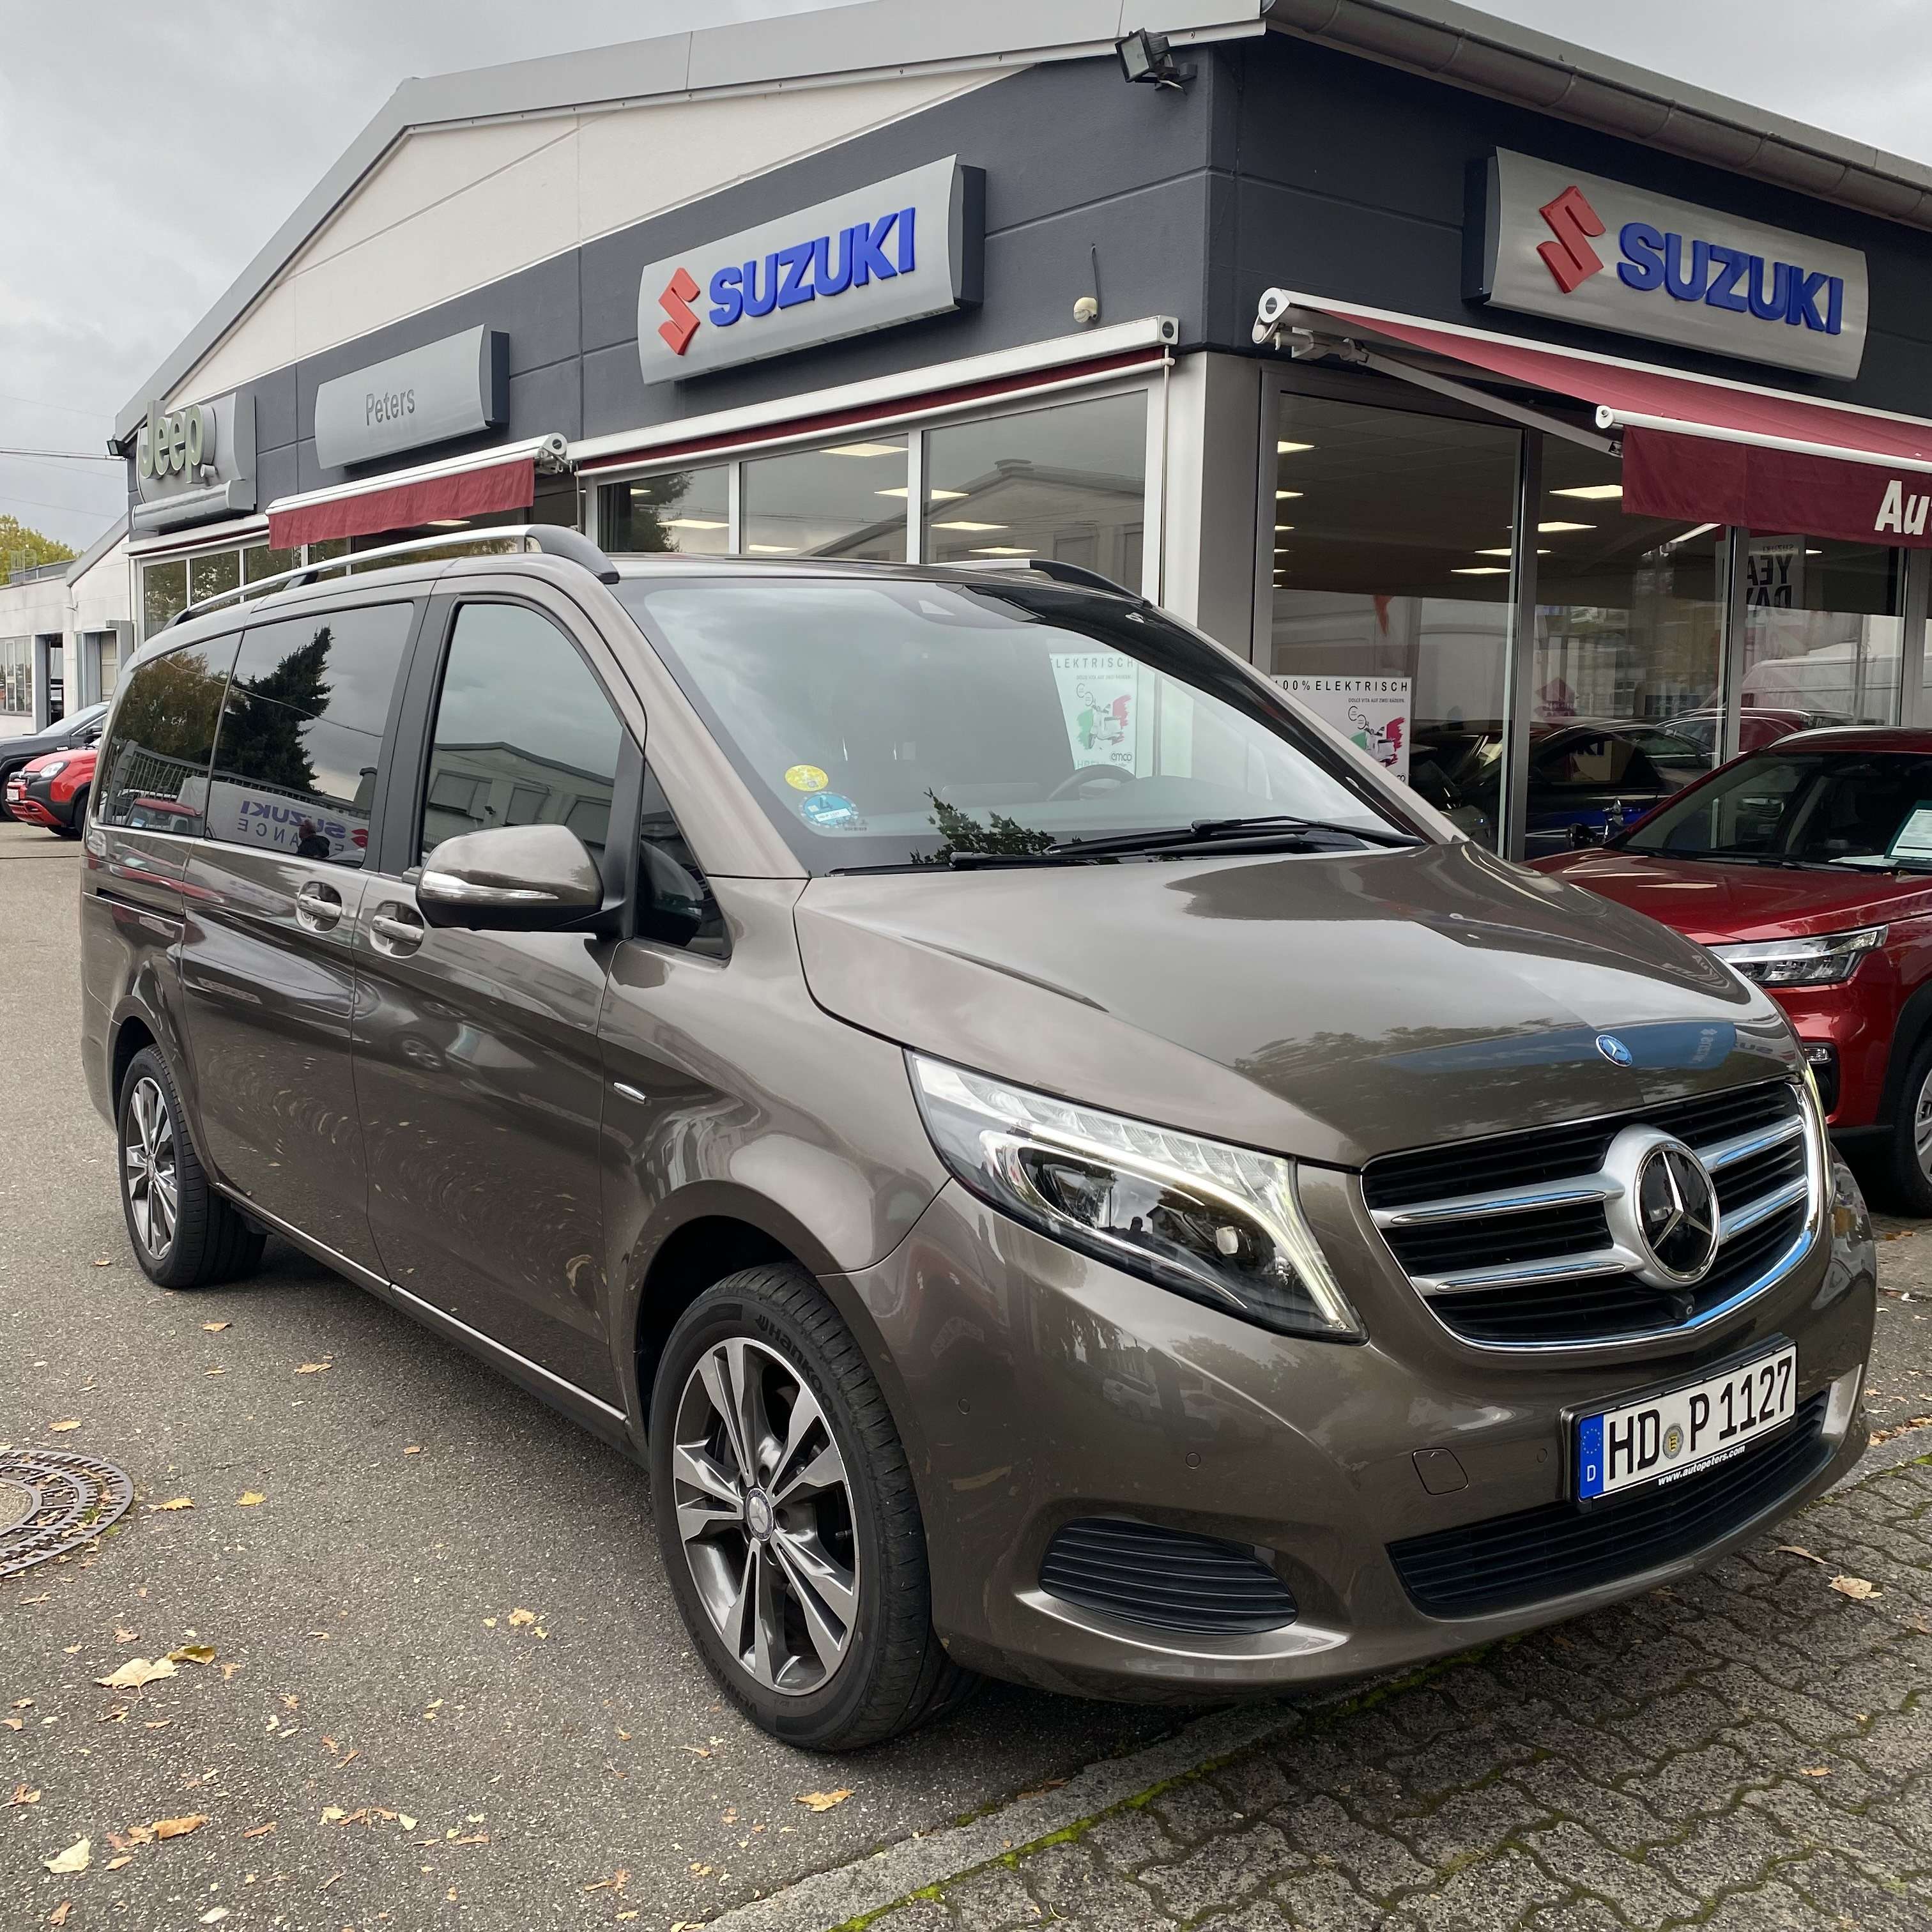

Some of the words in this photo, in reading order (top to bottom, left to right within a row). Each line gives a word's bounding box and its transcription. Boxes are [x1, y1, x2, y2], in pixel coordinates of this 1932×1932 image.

[709, 206, 916, 326] SUZUKI
[1617, 222, 1844, 335] SUZUKI
[366, 389, 415, 426] Peters
[138, 399, 208, 484] Jeep
[1874, 480, 1932, 535] Au
[1275, 680, 1310, 691] 00%
[1315, 680, 1407, 692] ELEKTRISCH
[1609, 1408, 1660, 1480] HD
[1689, 1393, 1710, 1452] P
[1719, 1355, 1793, 1441] 1127
[1586, 1464, 1597, 1482] D
[1657, 1444, 1746, 1486] www.autopeters.com
